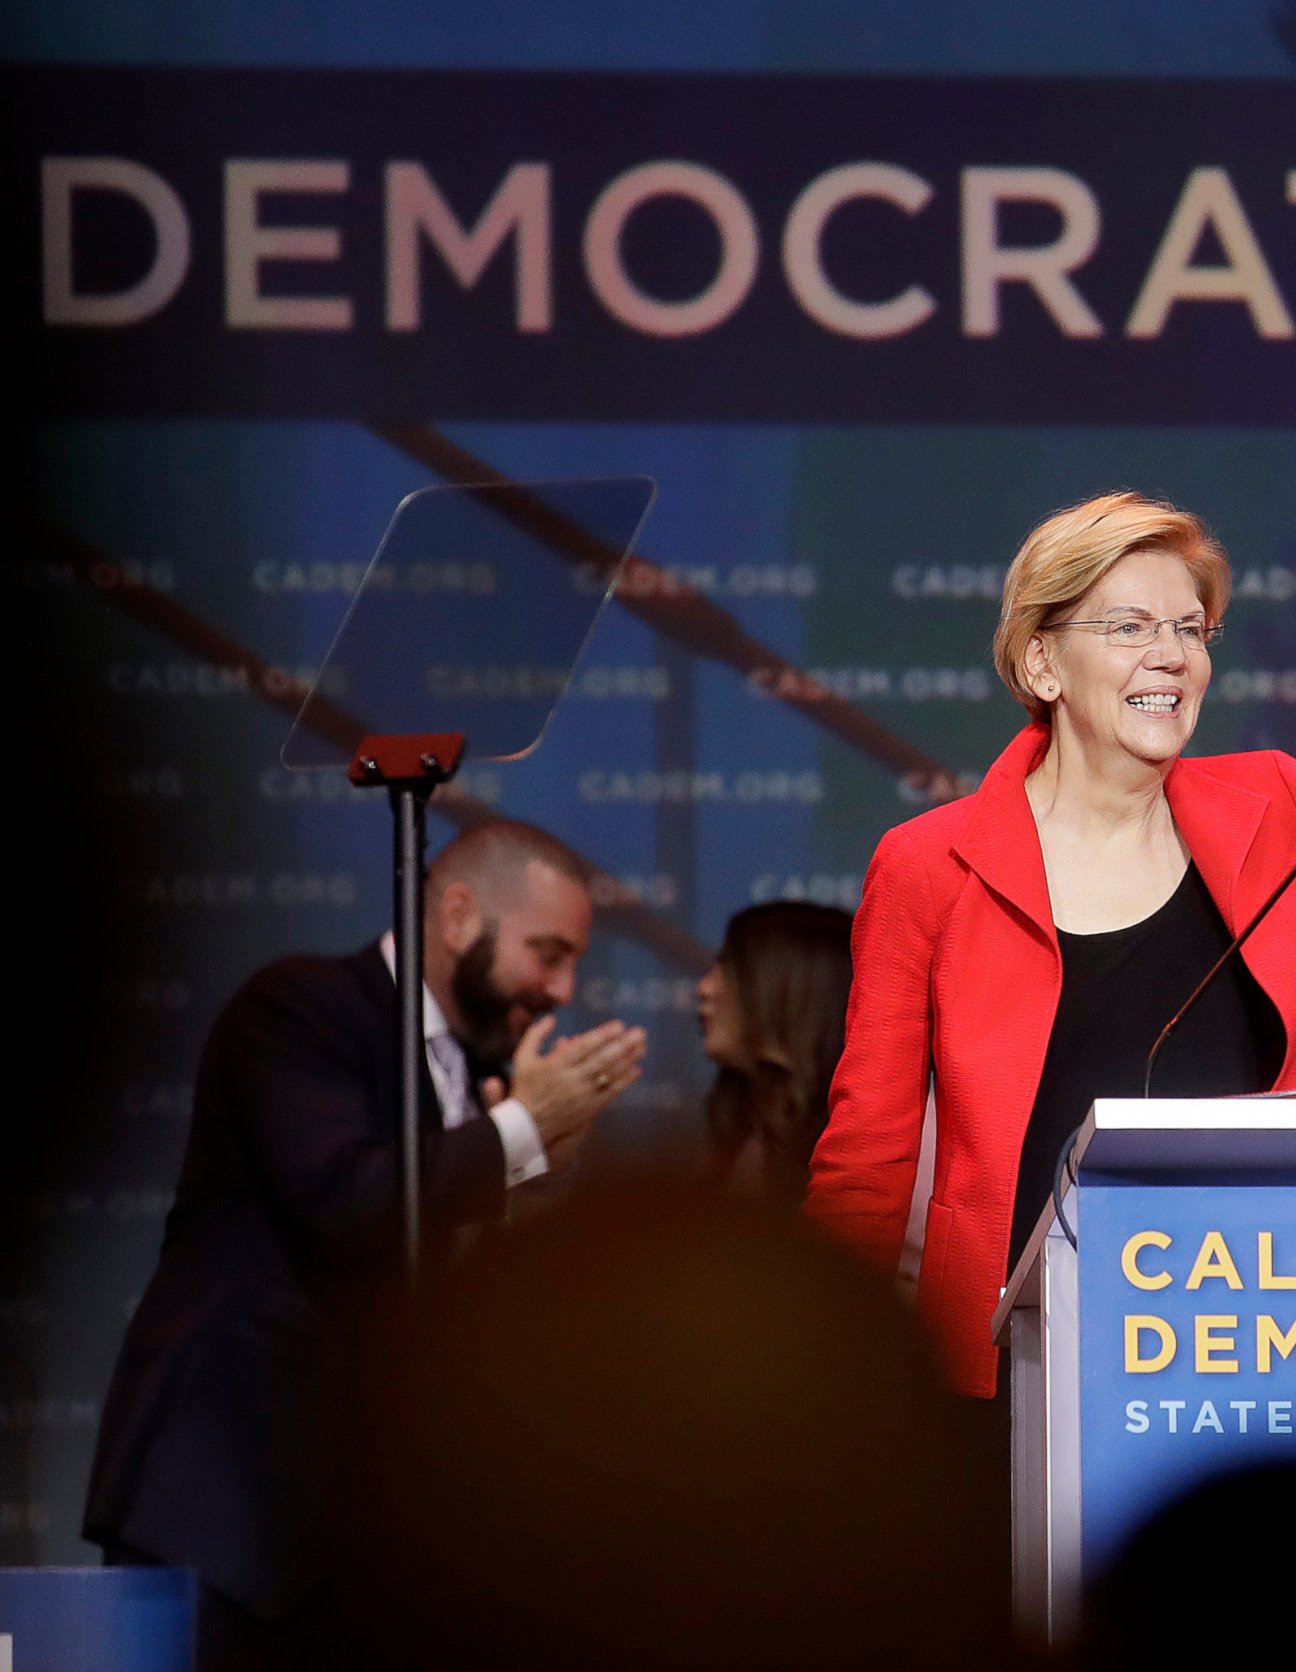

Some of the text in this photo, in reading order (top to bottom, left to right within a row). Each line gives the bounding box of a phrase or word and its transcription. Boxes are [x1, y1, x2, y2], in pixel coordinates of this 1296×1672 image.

[251, 561, 497, 595] CADEM.ORG
[747, 666, 992, 700] CADEM.ORG
[578, 769, 825, 804] CADEM.ORG
[1125, 1400, 1293, 1434] STATE
